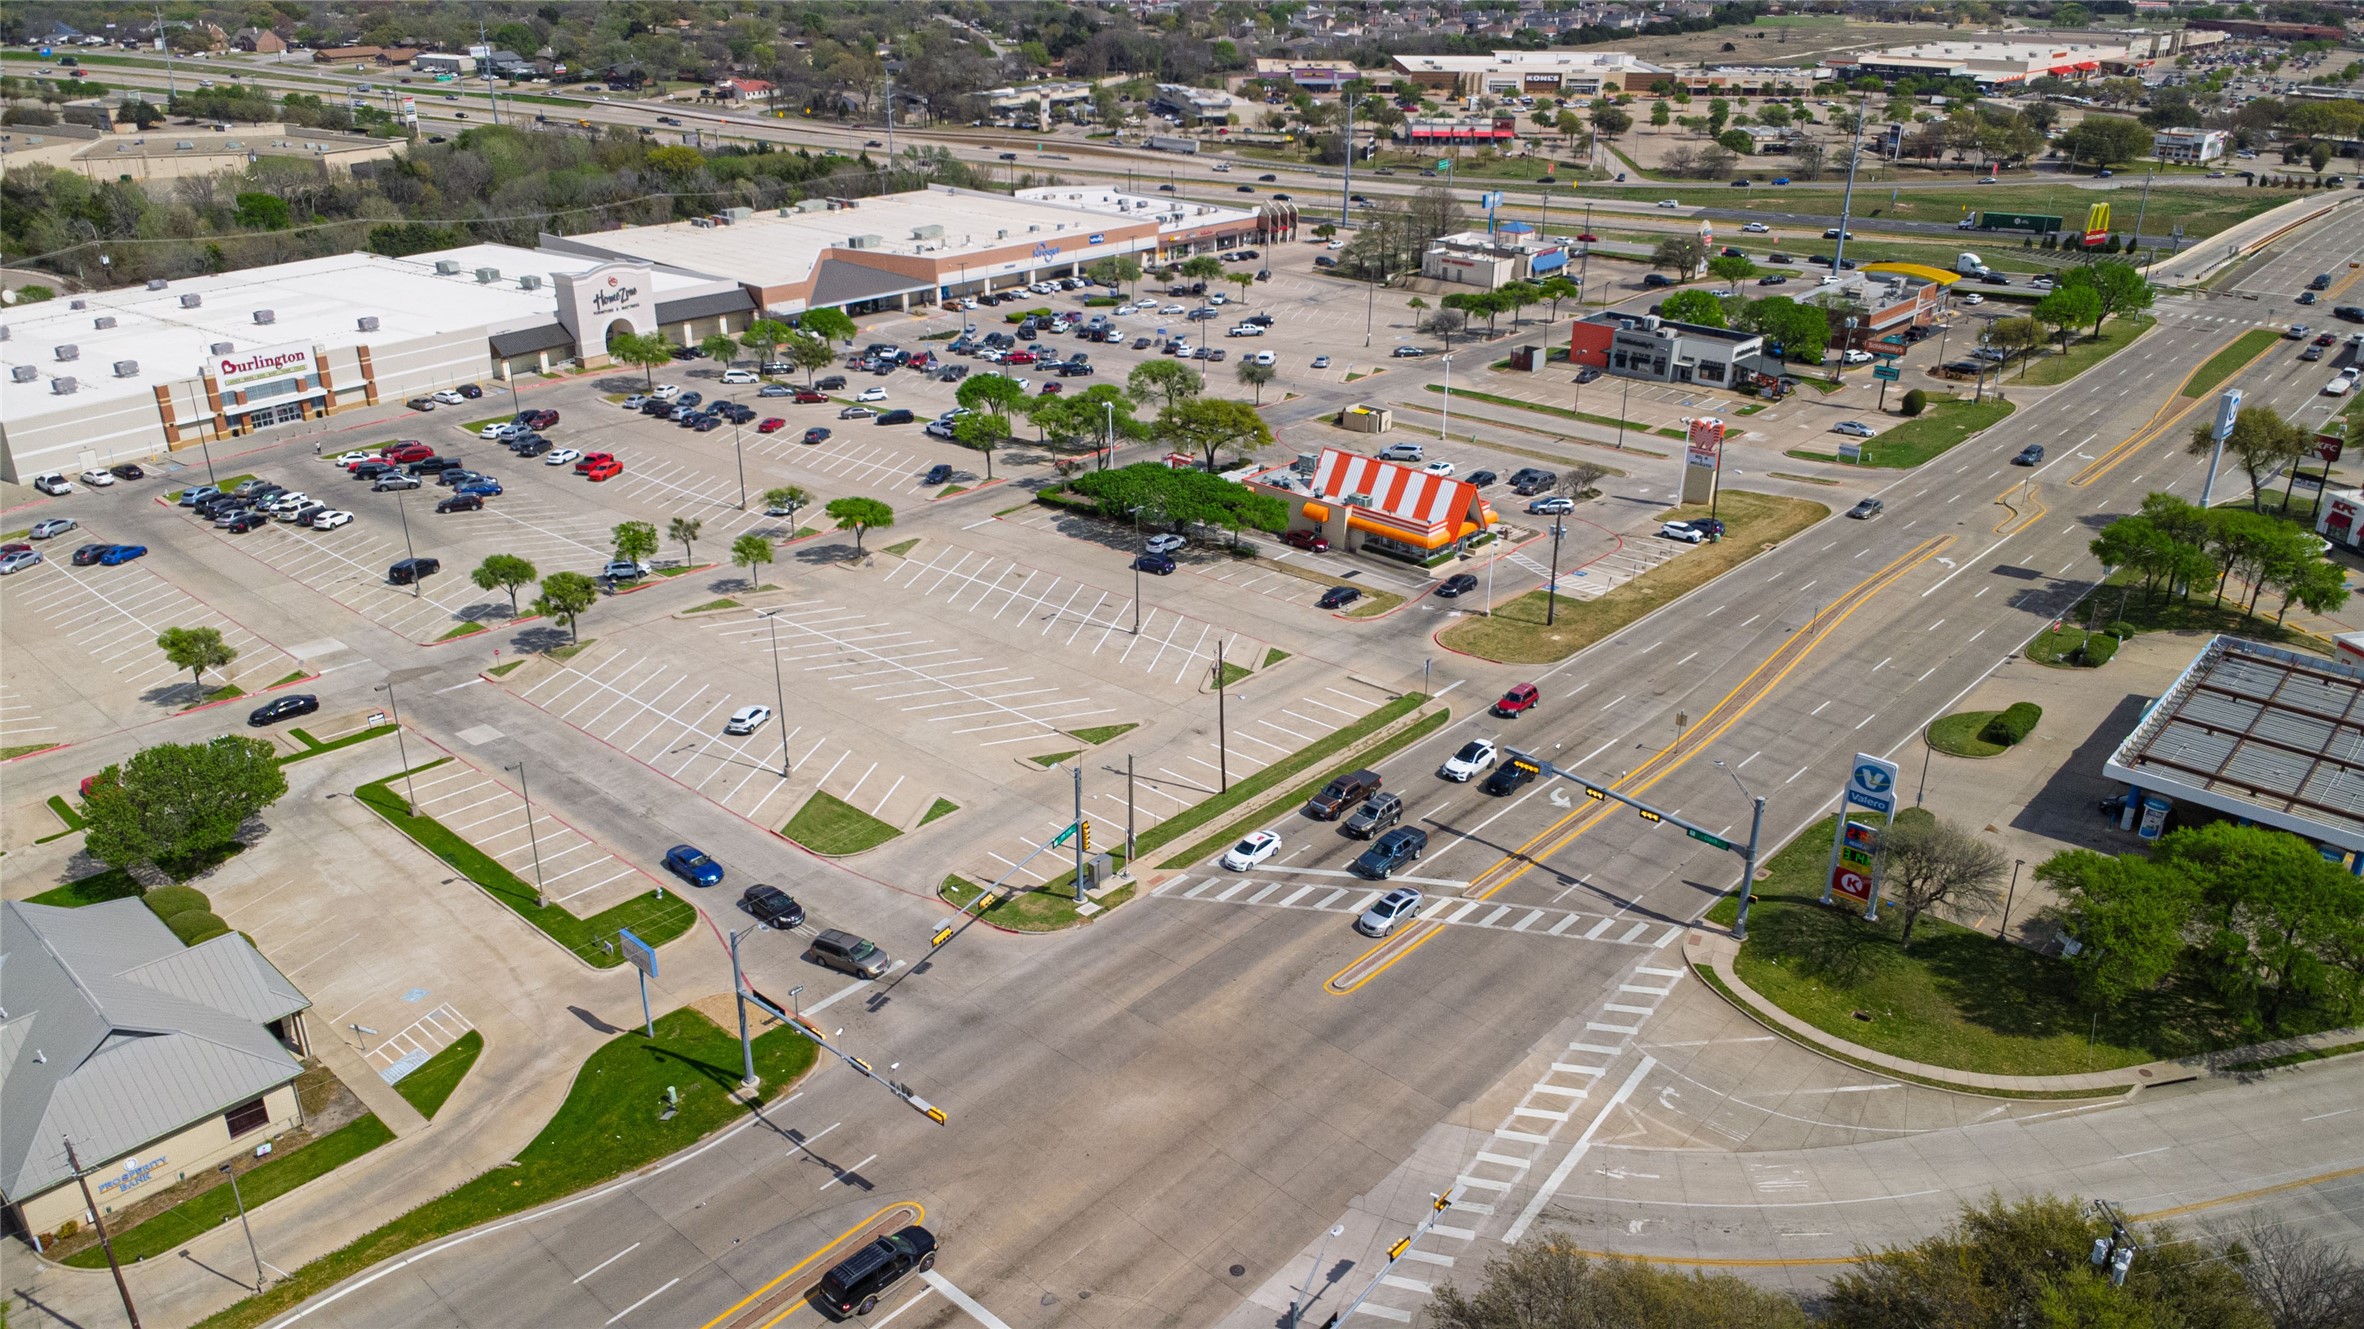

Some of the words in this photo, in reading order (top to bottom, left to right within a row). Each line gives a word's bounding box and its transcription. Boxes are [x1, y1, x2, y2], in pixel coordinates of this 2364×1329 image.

[221, 351, 305, 375] Burlington
[2331, 499, 2358, 516] KFC
[1851, 791, 1886, 811] Valero
[98, 1156, 167, 1192] PROSPERITY
[120, 1172, 151, 1192] BANK
